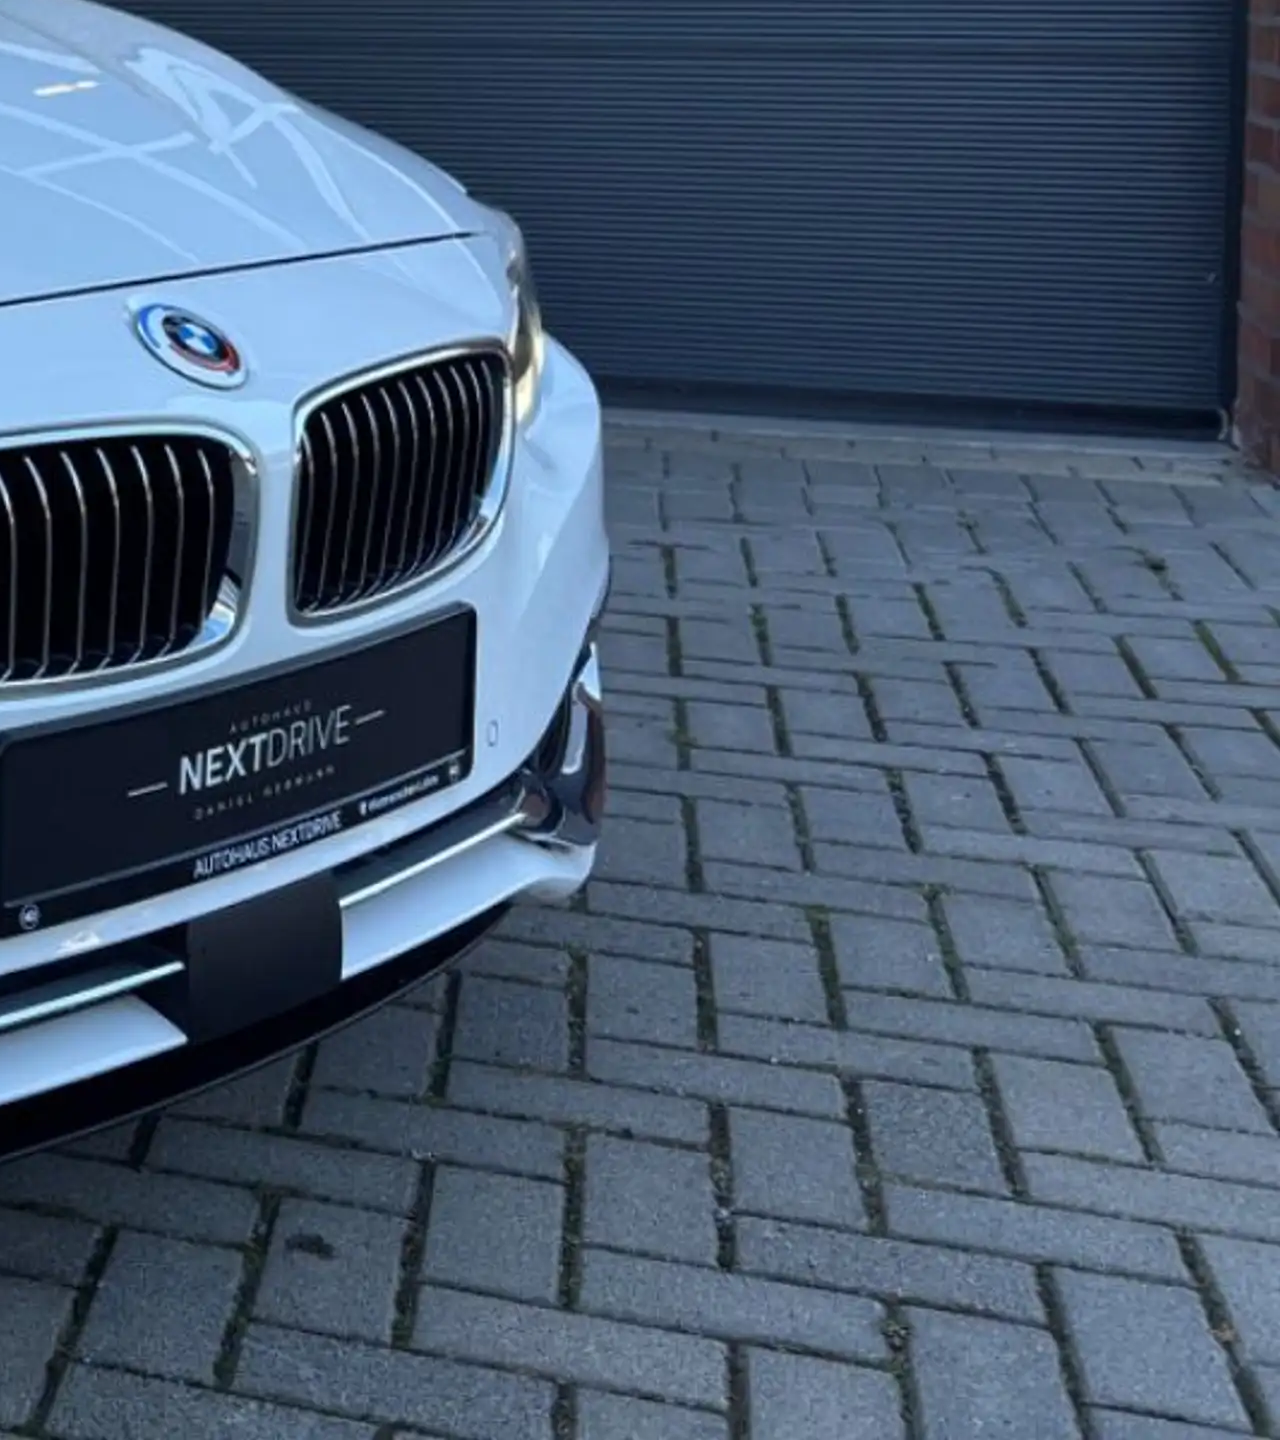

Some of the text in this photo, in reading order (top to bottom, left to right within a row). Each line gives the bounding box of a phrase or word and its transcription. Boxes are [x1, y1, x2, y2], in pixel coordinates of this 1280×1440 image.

[179, 704, 352, 795] NEXTDRIVE
[193, 810, 344, 879] AUTOHAUS NEXTDRIVE
